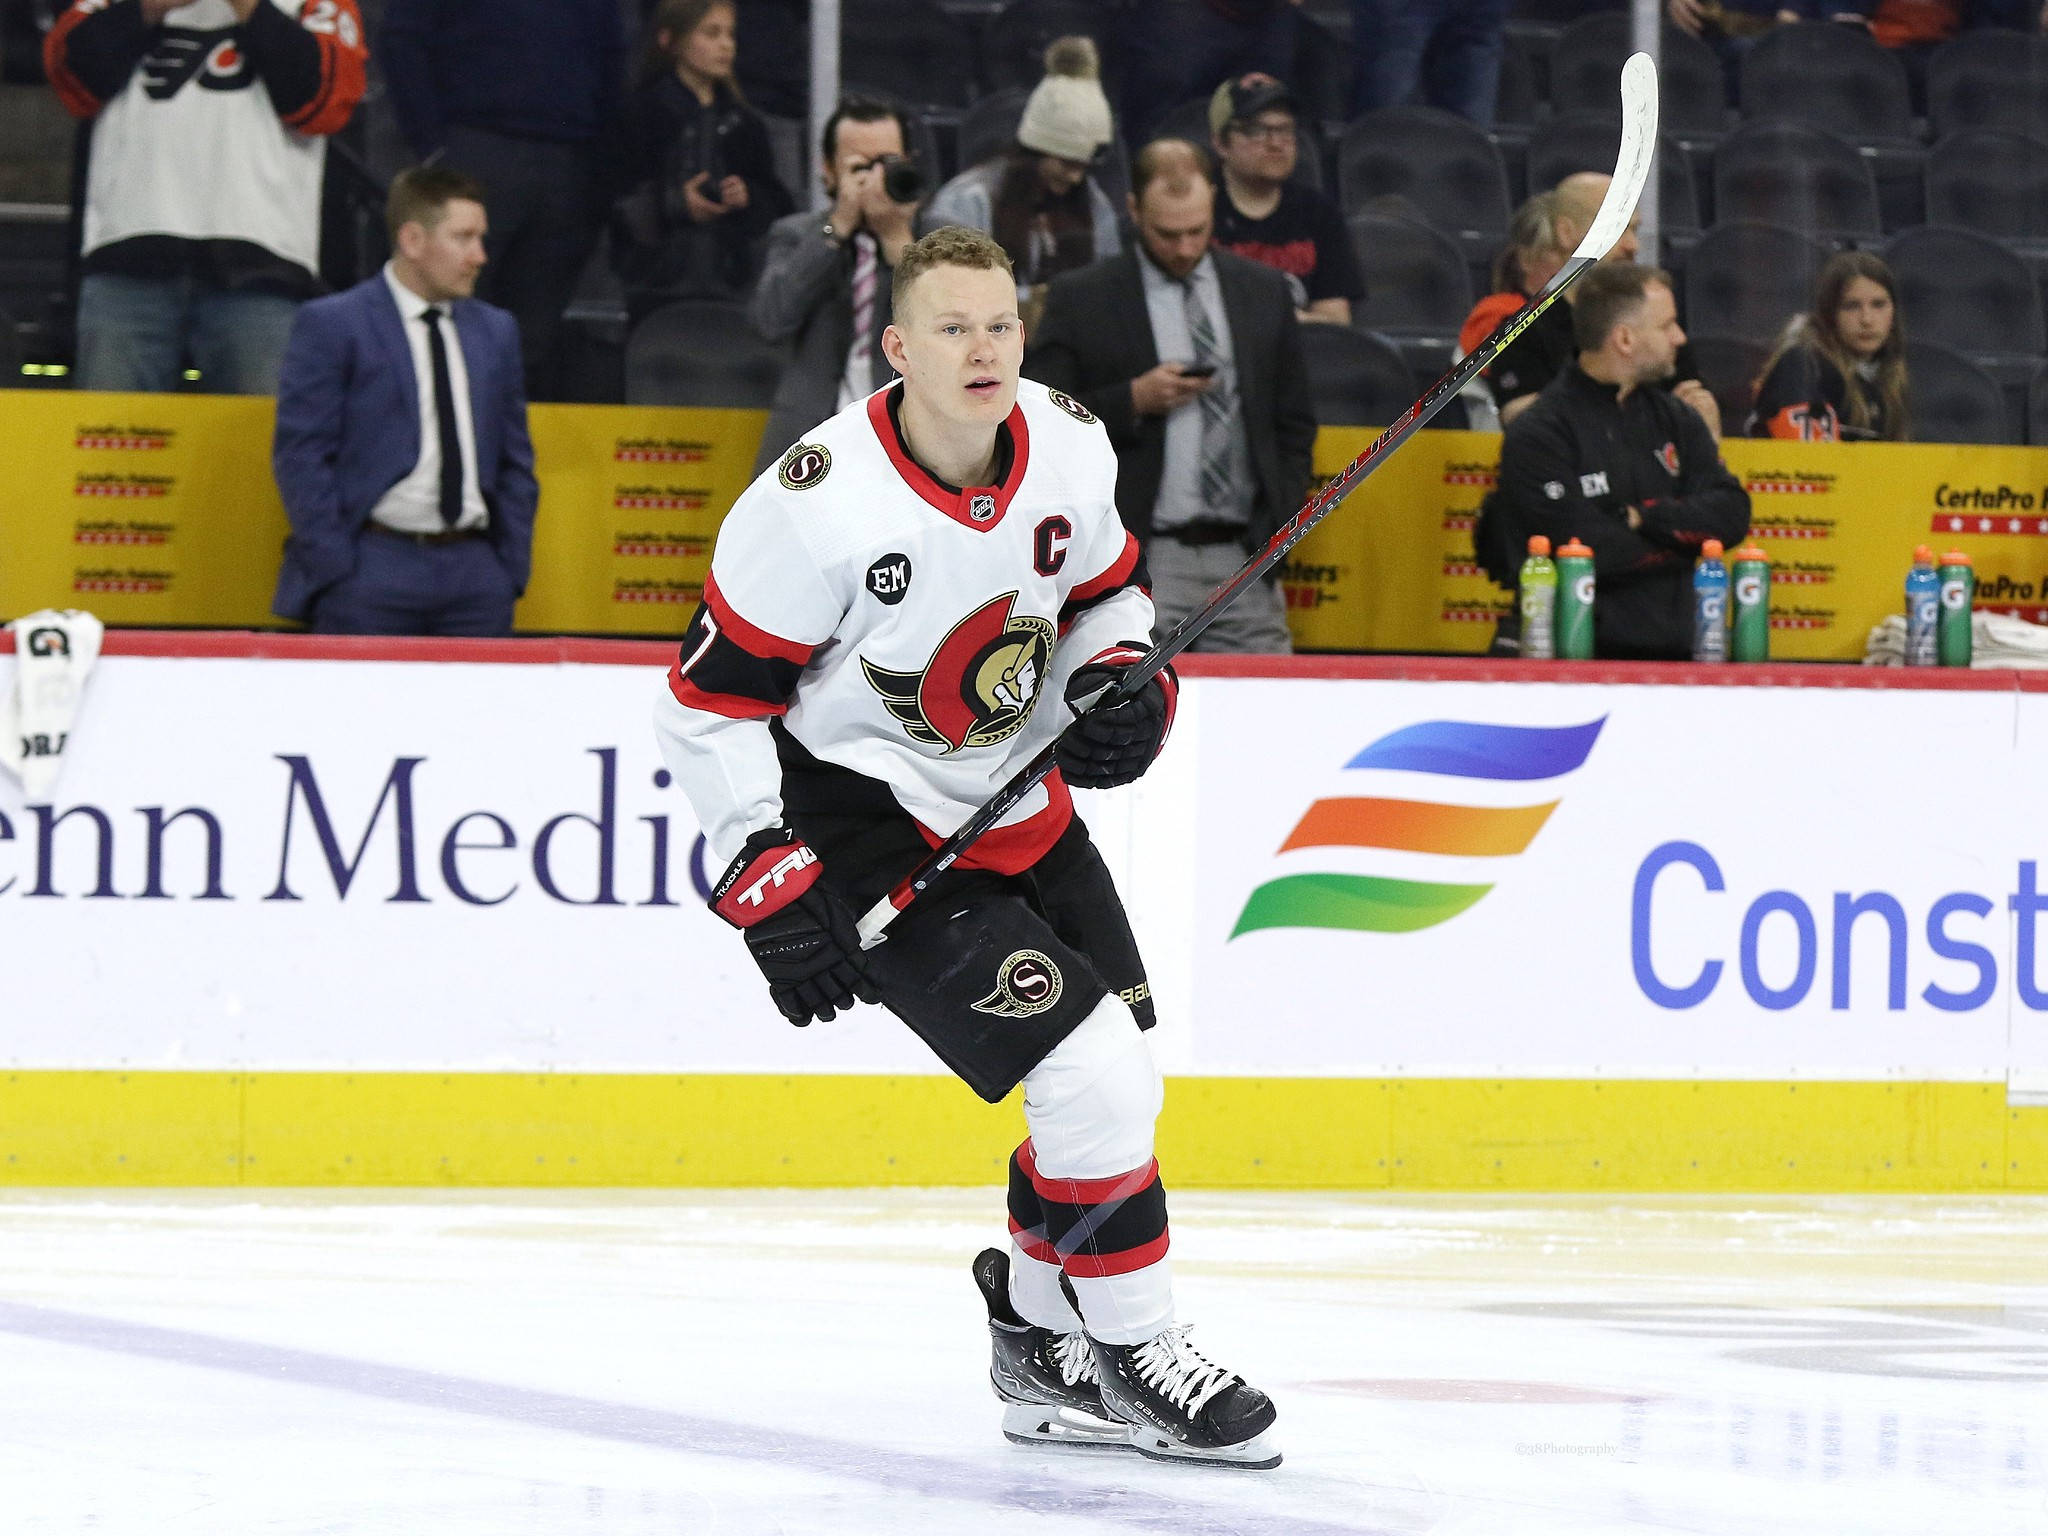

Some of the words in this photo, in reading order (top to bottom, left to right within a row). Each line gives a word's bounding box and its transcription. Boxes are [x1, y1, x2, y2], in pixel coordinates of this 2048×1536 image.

[1580, 471, 1610, 498] EM
[1935, 484, 2034, 509] CertaPro
[1272, 494, 1342, 560] CATALYST
[1034, 515, 1071, 577] C
[872, 560, 907, 594] EM
[1736, 576, 1762, 606] G
[1974, 575, 2034, 600] taPro
[1941, 580, 1966, 609] G
[28, 627, 71, 657] G
[680, 605, 719, 677] 7
[0, 803, 236, 900] nn
[262, 747, 714, 908] Medi
[784, 828, 793, 841] 7
[716, 858, 747, 898] TKACHUK
[1631, 840, 2048, 1012] Const
[1013, 962, 1049, 1000] S
